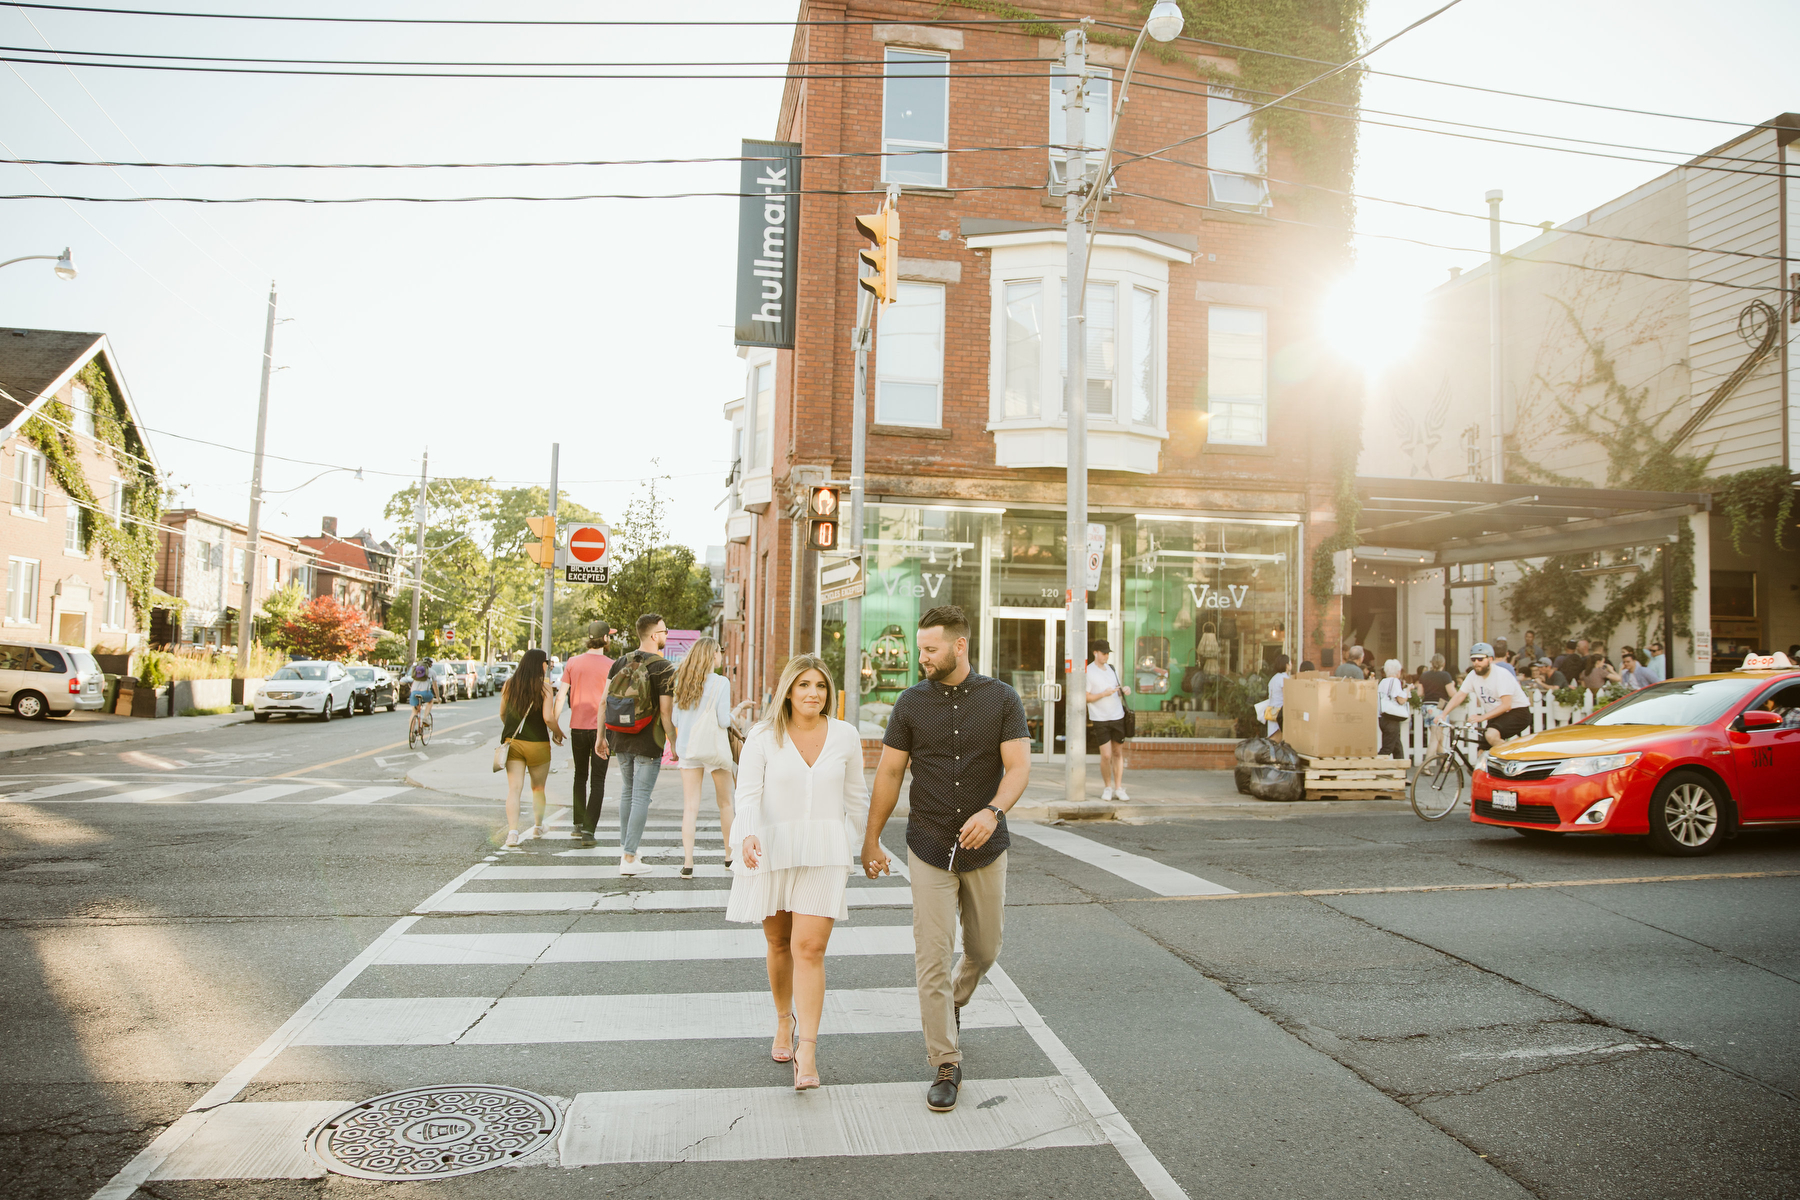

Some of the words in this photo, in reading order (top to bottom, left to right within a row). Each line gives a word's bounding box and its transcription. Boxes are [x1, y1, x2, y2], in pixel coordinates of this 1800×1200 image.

[751, 165, 787, 323] hullmark
[819, 522, 833, 546] 10
[570, 564, 604, 573] BICYCLES
[568, 573, 606, 581] EXCEPTED
[821, 590, 841, 601] BICYCLES
[841, 584, 863, 597] EXCEPTED
[1041, 588, 1059, 598] 120
[1747, 657, 1775, 667] co-op
[1751, 746, 1773, 768] 3187
